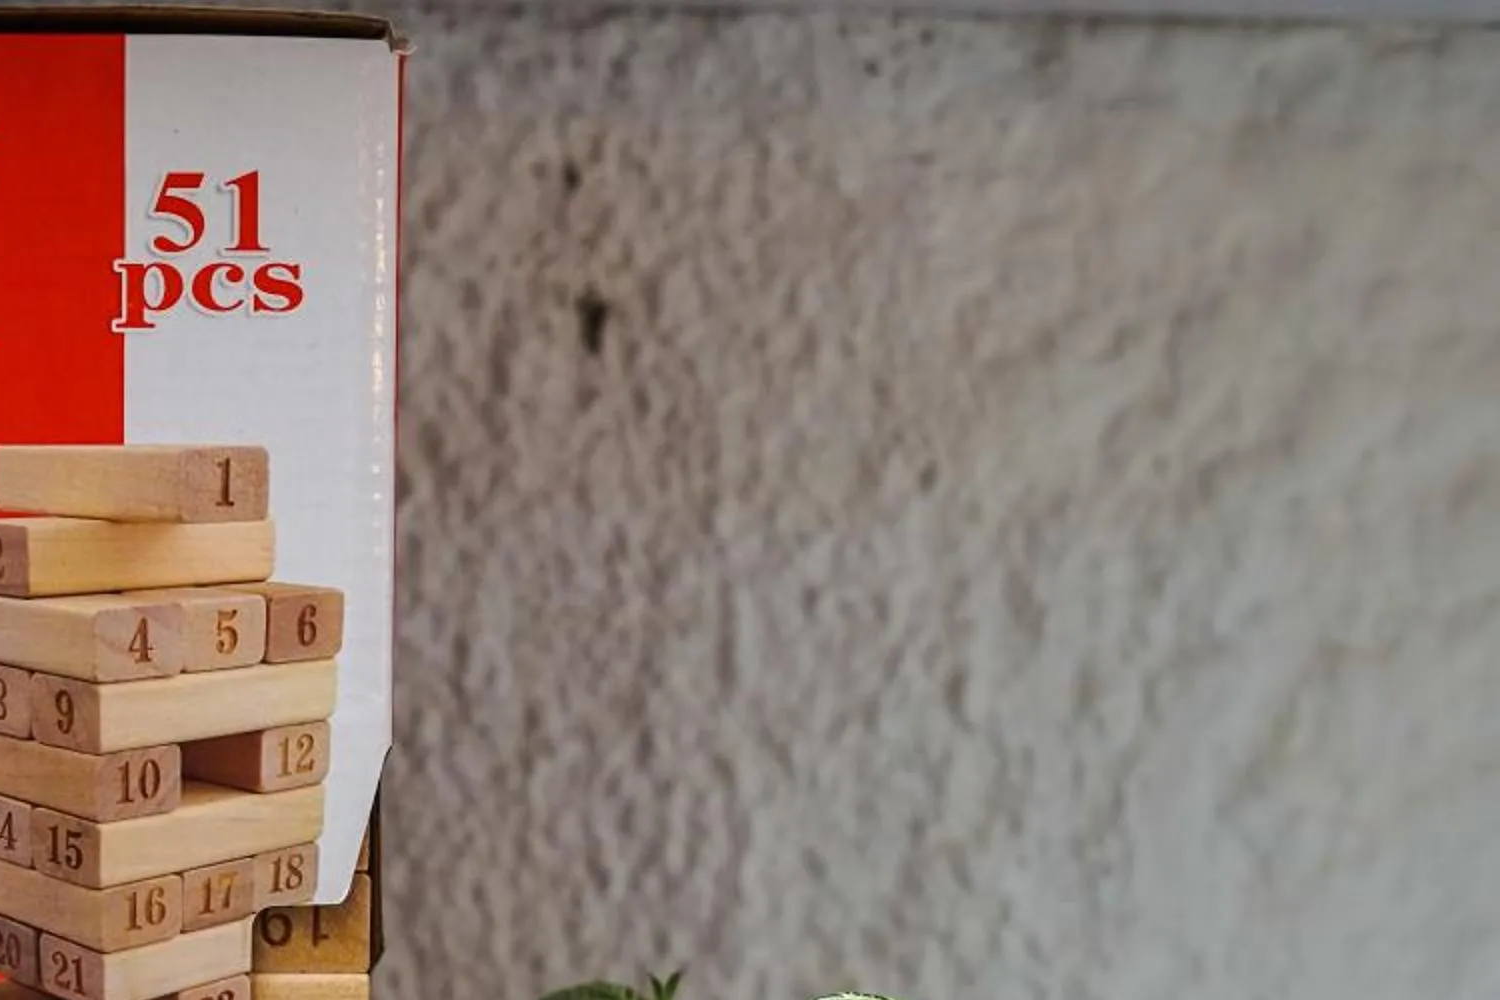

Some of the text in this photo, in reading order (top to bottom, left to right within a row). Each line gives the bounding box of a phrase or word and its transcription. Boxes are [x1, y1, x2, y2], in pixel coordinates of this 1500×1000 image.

[150, 168, 270, 256] 51
[113, 260, 303, 332] pcs
[216, 457, 235, 507] 1
[129, 605, 318, 663] 4 5 6
[55, 689, 75, 735] 9
[117, 732, 315, 804] 10 12
[47, 826, 83, 869] 15
[125, 854, 304, 931] 16 17 18
[51, 951, 88, 995] 21
